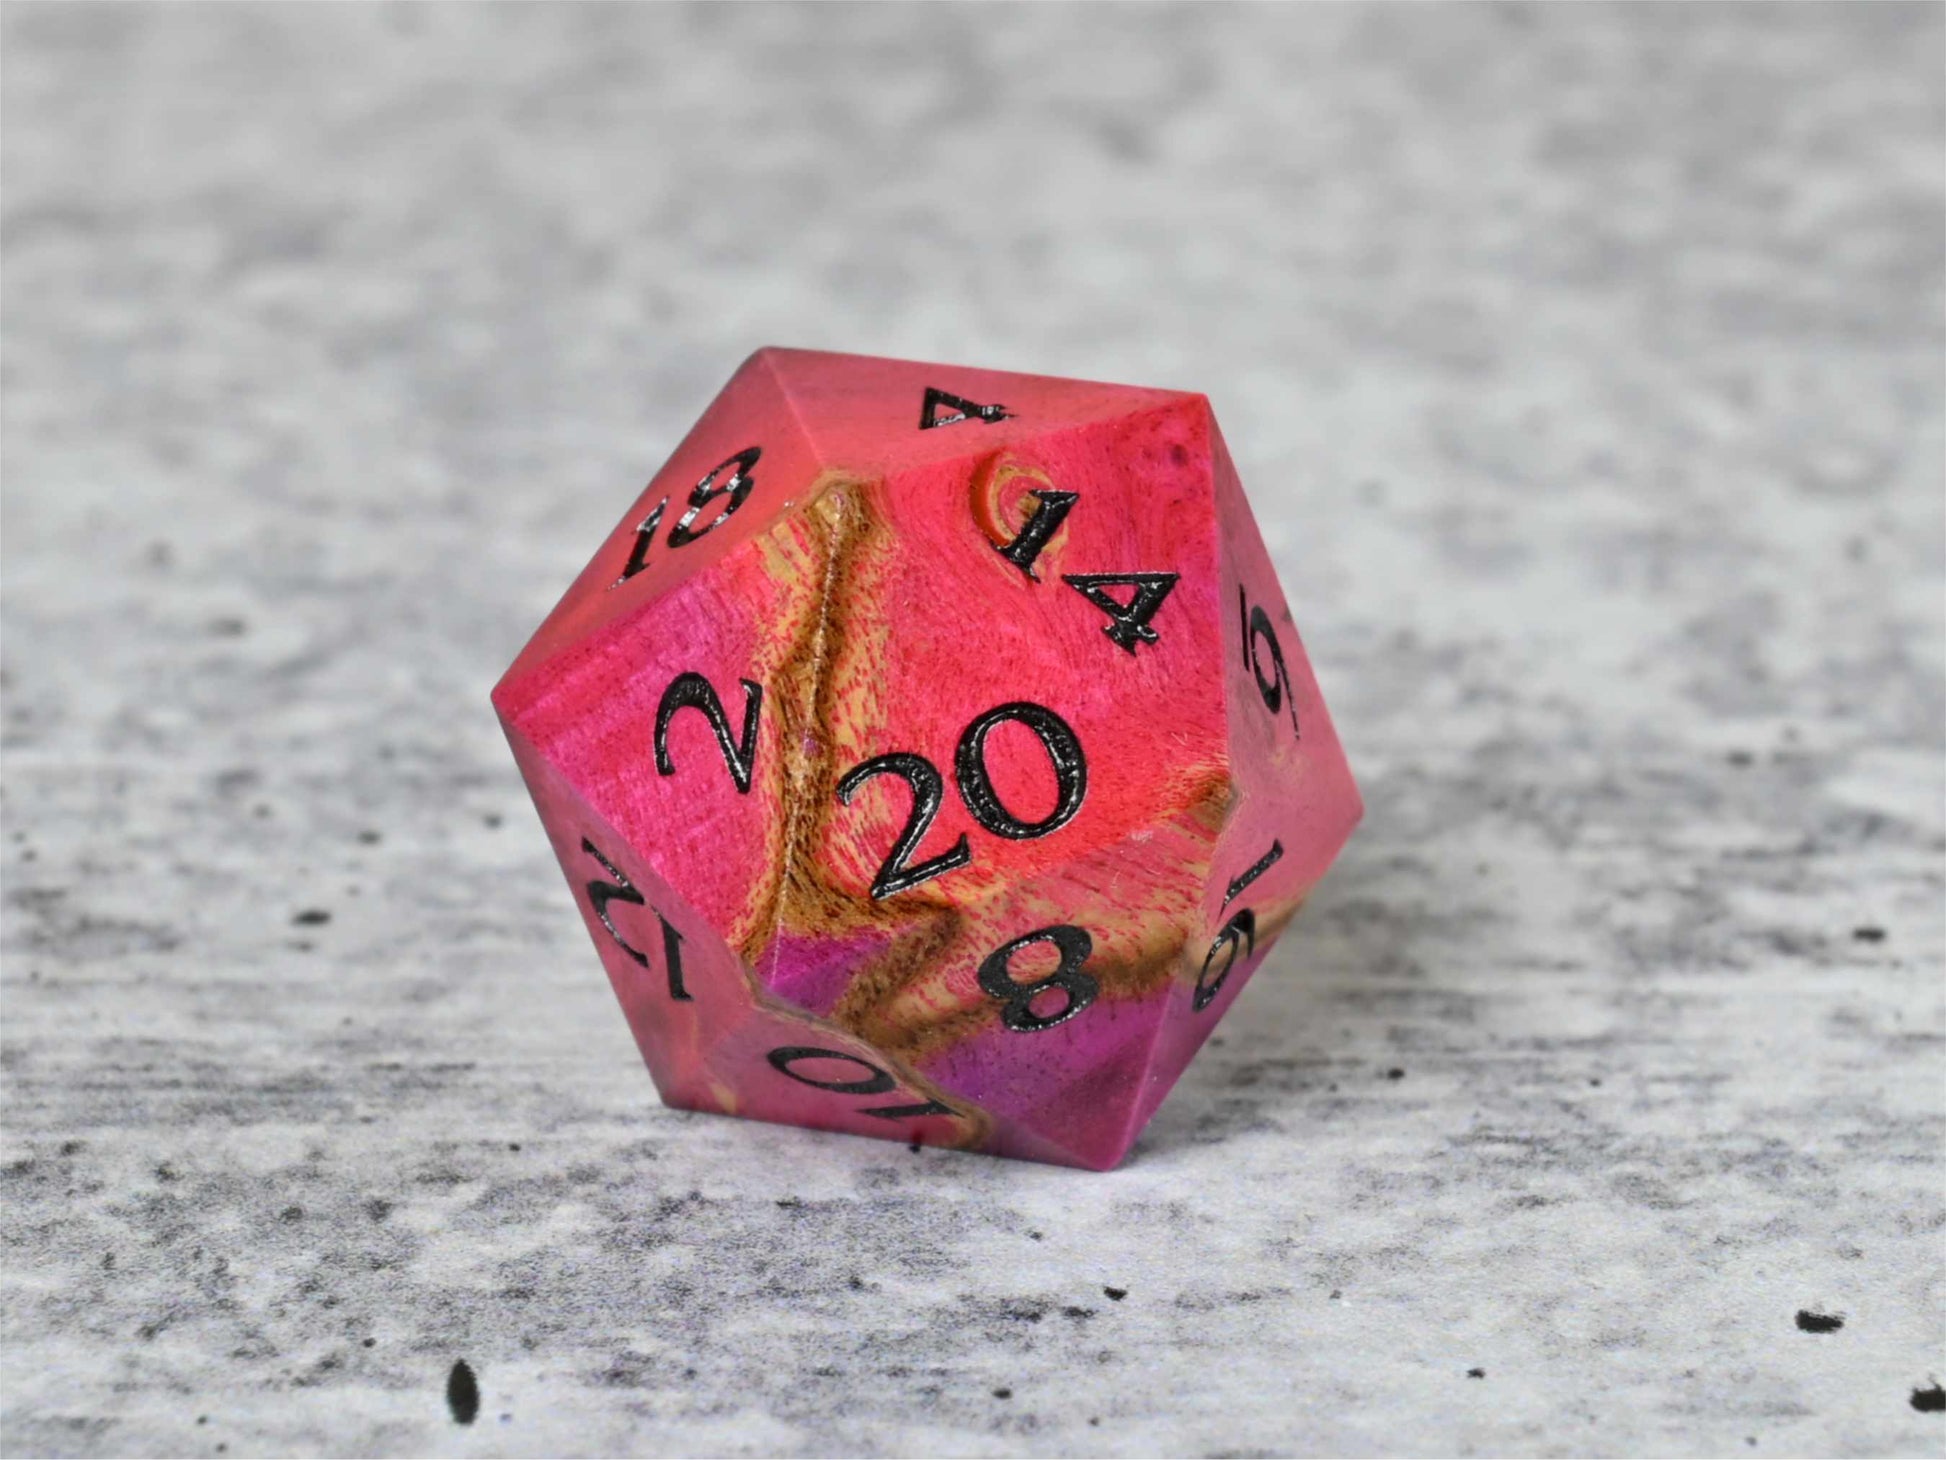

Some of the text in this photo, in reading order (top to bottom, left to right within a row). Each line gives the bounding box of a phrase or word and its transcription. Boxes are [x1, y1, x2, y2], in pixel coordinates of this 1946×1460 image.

[919, 386, 1017, 430] 4
[607, 446, 761, 590] 18
[993, 489, 1181, 656] 14
[653, 671, 763, 794] 2
[837, 701, 1088, 900] 20
[581, 837, 692, 1002] 12
[977, 924, 1101, 1033] 8
[1192, 838, 1285, 1012] 16
[767, 1046, 965, 1121] 10
